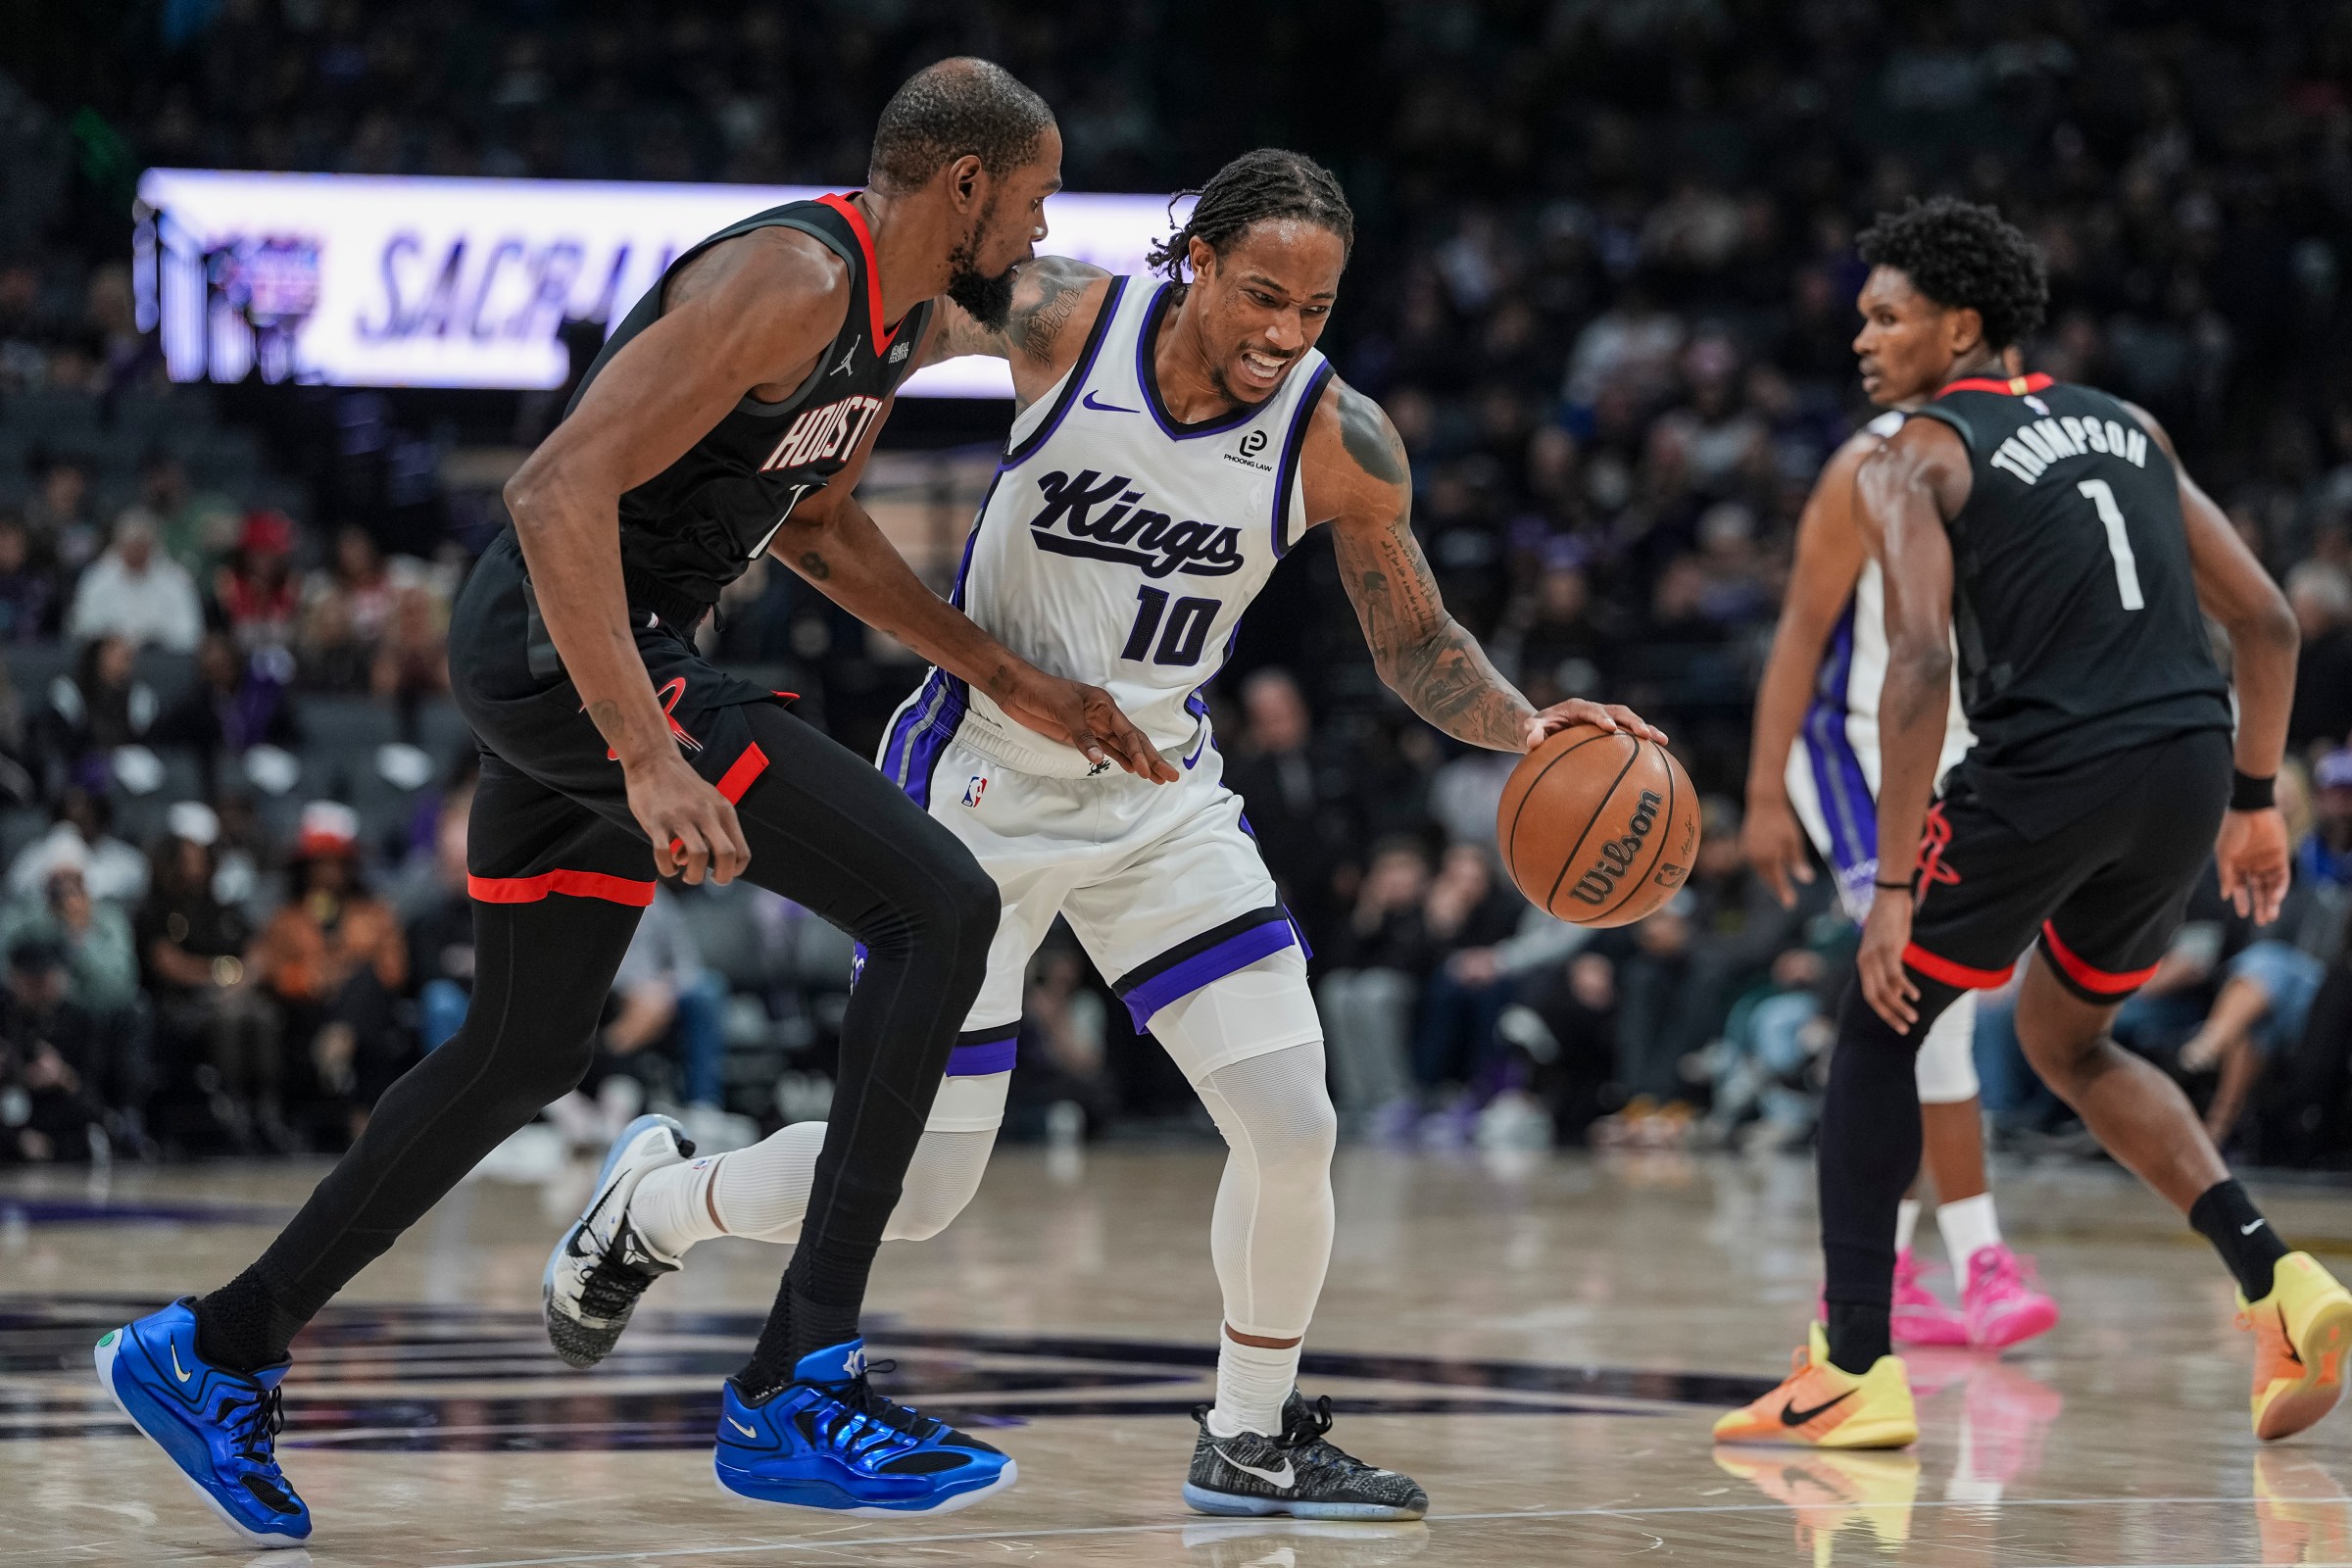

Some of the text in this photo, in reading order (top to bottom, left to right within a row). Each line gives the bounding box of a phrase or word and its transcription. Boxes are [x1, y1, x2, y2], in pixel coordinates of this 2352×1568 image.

[759, 394, 883, 472] HOUST
[1223, 453, 1273, 472] PHOONG LAW
[1990, 415, 2148, 486] THOMPSON
[1030, 468, 1245, 579] Kings
[2077, 478, 2145, 611] 1
[1120, 583, 1223, 667] 10
[1569, 787, 1664, 906] Wilson
